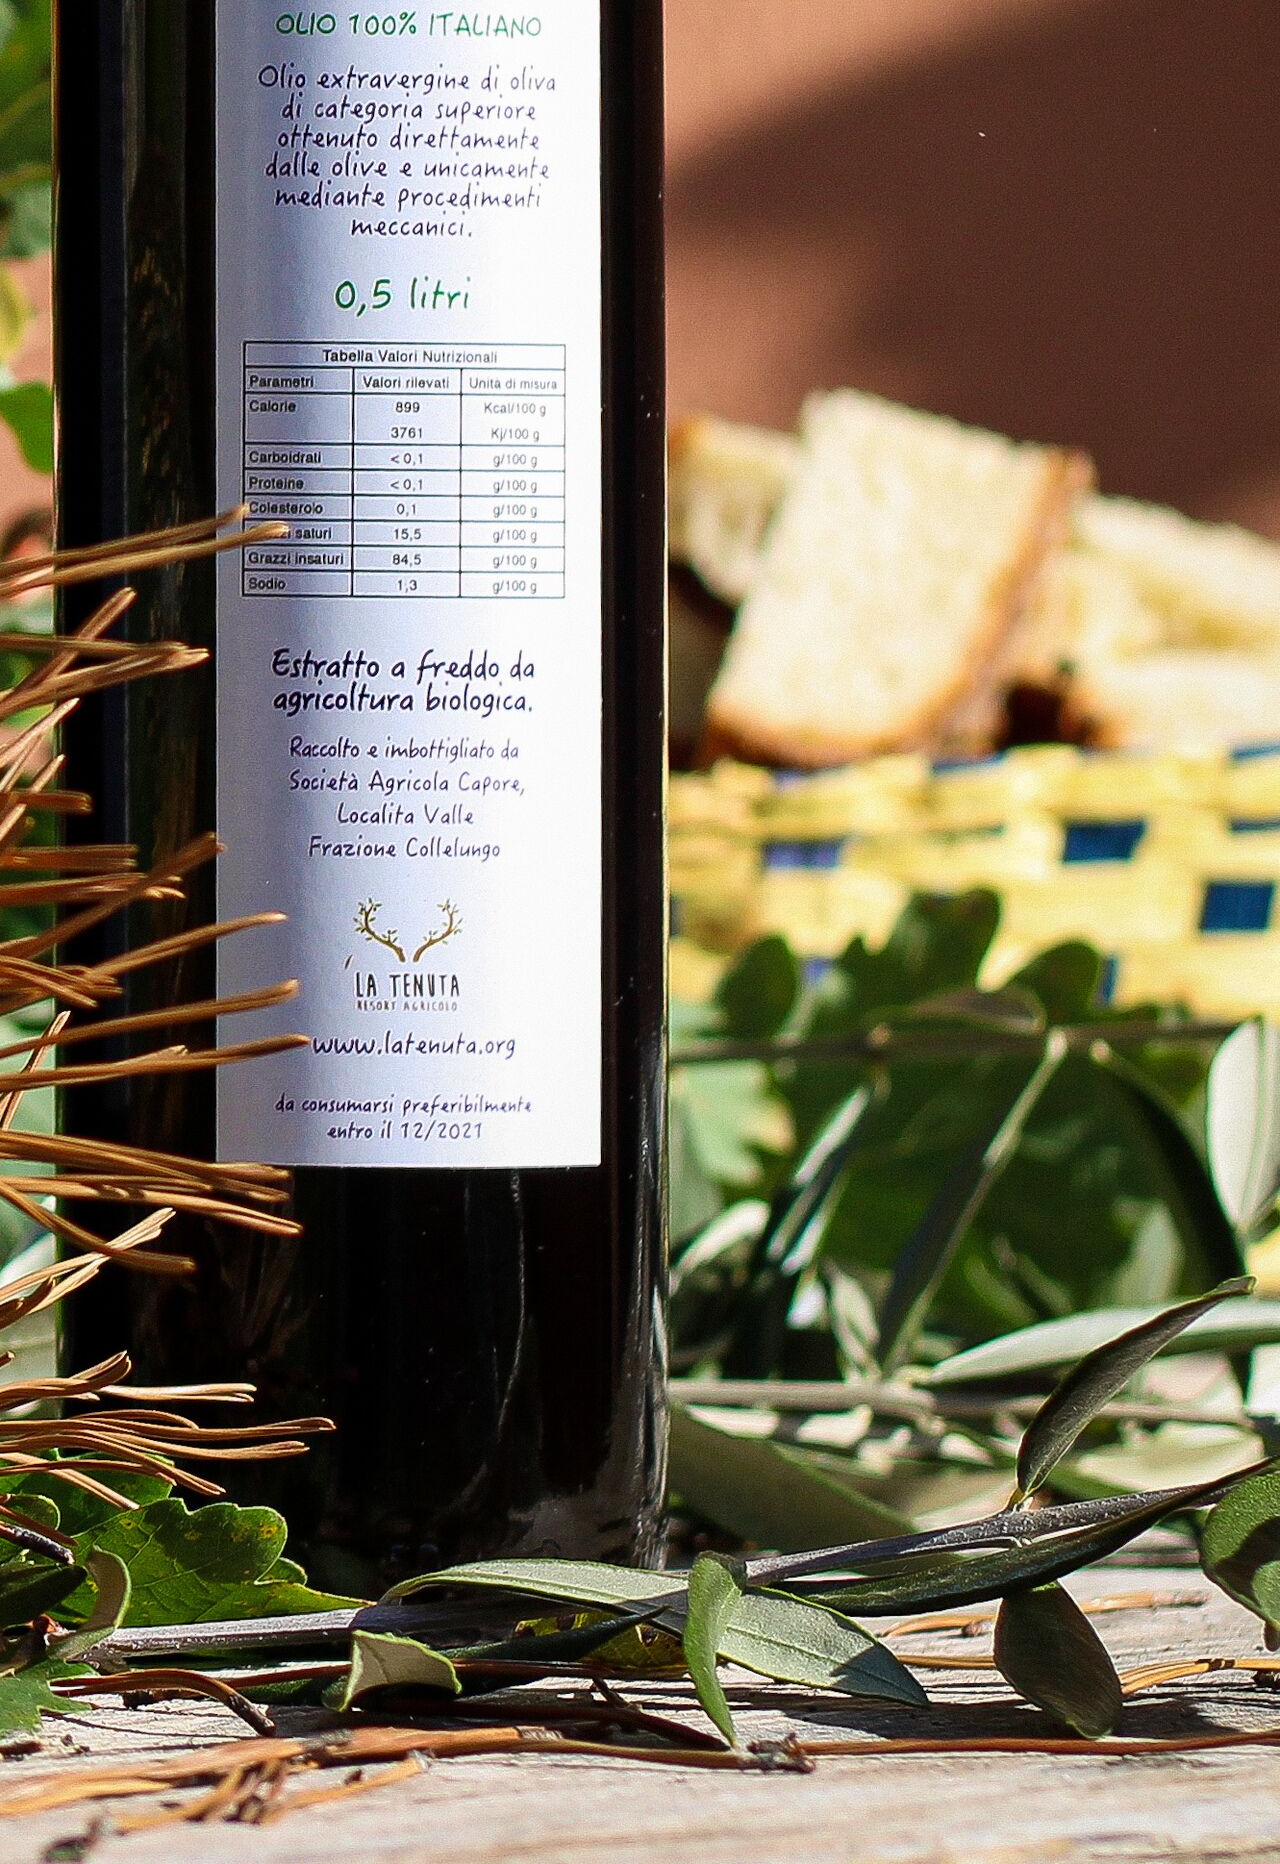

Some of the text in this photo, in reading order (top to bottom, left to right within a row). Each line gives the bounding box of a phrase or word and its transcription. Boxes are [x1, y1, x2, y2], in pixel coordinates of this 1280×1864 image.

[276, 12, 542, 37] OLIO 100% ITALIANO
[258, 63, 557, 95] Olio extravergine di oliva
[282, 92, 537, 125] di categoria superiore
[278, 122, 539, 151] ottenuto direttamente
[266, 151, 550, 180] dalle olive e unicamente
[275, 180, 540, 212] mediante procedimenti
[351, 209, 473, 237] meccanici.
[335, 277, 471, 316] 0,5 litri
[323, 349, 498, 364] Tabella Valori Nutrizionali
[249, 375, 314, 388] Parametri
[363, 376, 450, 389] Valori rilevati
[505, 377, 516, 390] di
[520, 379, 558, 390] misura
[249, 400, 296, 412] Calorie
[395, 401, 420, 413] 899
[484, 402, 546, 417] Kcal/100 g
[391, 427, 423, 439] 3761
[533, 430, 540, 442] g
[249, 451, 321, 464] Carboidrati
[390, 453, 423, 466] < 0,1
[493, 454, 538, 468] g/100 g
[248, 476, 304, 490] Proteine
[390, 478, 423, 492] < 0,1
[493, 480, 537, 494] g/100 g
[249, 501, 323, 514] Colesterolo
[396, 503, 417, 517] 0,1
[493, 504, 537, 519] g/100 g
[295, 527, 332, 539] saturi
[394, 528, 422, 541] 15,5
[493, 529, 537, 544] g/100 g
[248, 552, 344, 565] Grazzi insaturi
[392, 553, 422, 566] 84,5
[493, 554, 537, 569] g/100 g
[248, 577, 286, 590] Sodio
[397, 578, 418, 592] 1,3
[493, 580, 537, 595] g/100 g
[271, 648, 535, 684] Estratto a freddo da
[273, 680, 533, 718] agricoltura biologica.
[290, 737, 519, 763] Raccolto e imbottigliato da
[289, 768, 525, 796] Società Agricola Capore,
[336, 801, 474, 825] Localita Valle
[308, 836, 501, 859] Frazione Collelungo
[356, 972, 460, 997] LA TENUTA
[312, 1031, 515, 1058] www.latenuta.org
[275, 1093, 532, 1115] da consumarsi preferibilmente
[327, 1122, 482, 1140] entro il 12/2021
